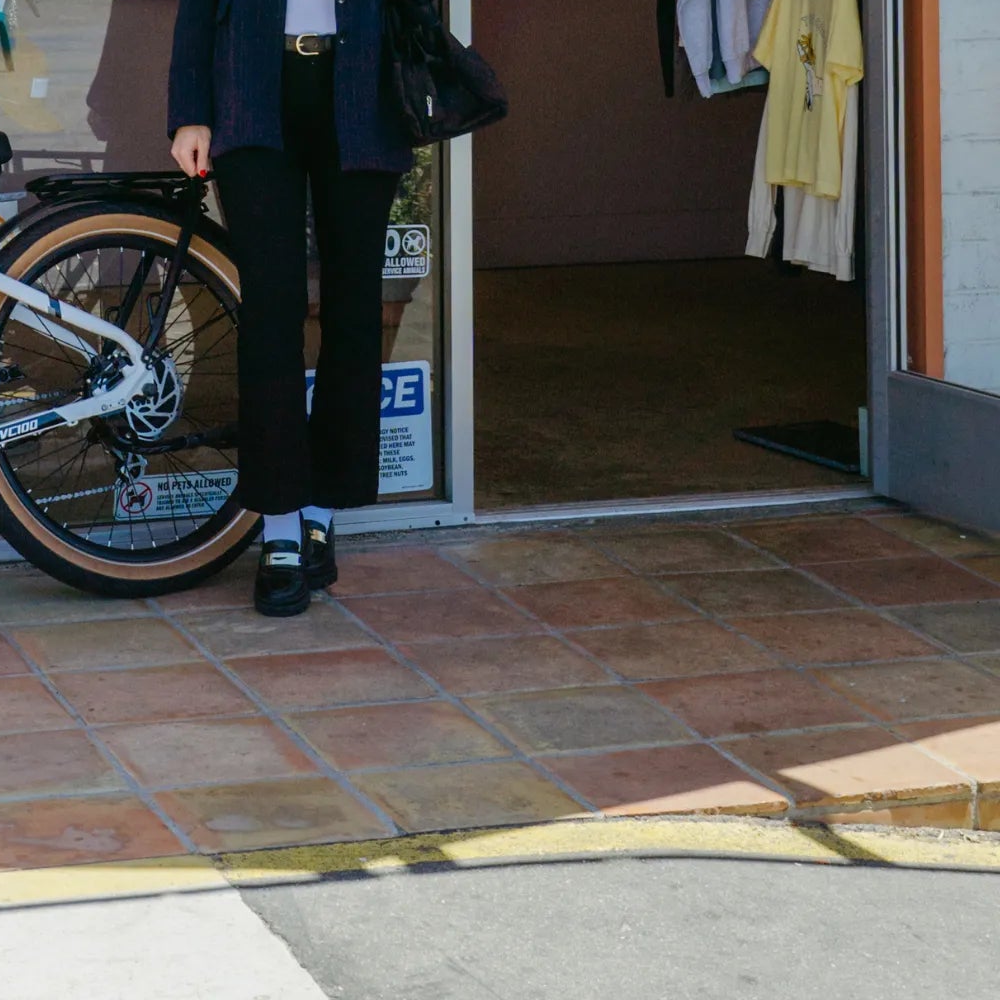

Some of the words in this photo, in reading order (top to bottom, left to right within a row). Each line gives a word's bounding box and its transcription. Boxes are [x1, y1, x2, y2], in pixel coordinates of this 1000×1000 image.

[384, 257, 426, 268] ALLOWED
[0, 419, 39, 440] VC100
[157, 481, 169, 492] NO
[171, 480, 192, 491] PETS
[194, 476, 232, 490] ALLOWED
